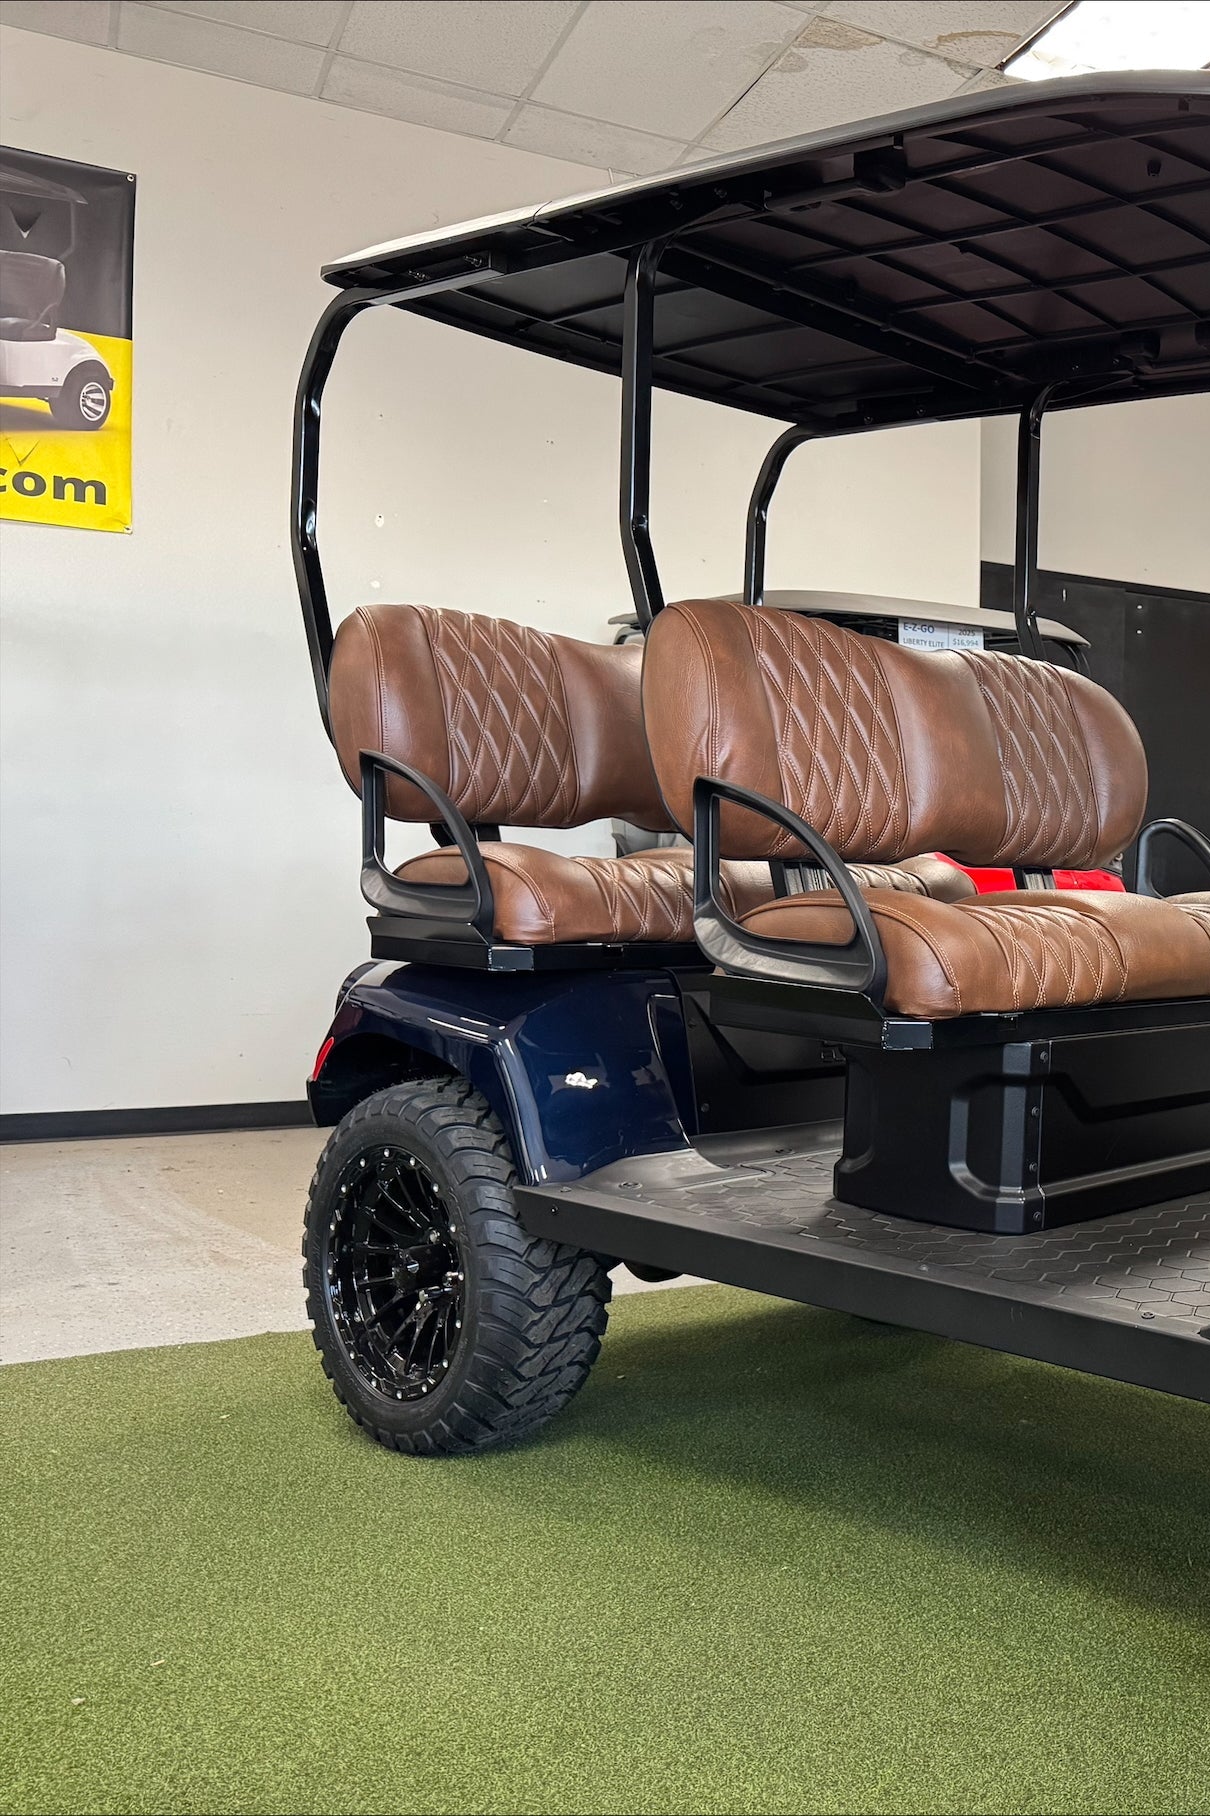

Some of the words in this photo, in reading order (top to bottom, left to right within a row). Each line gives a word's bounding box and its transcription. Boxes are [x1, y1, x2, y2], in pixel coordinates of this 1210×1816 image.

[903, 622, 935, 634] E-Z-GO
[958, 629, 976, 637] 2025
[903, 637, 928, 647] LIBERTY
[928, 640, 944, 649] ELITE
